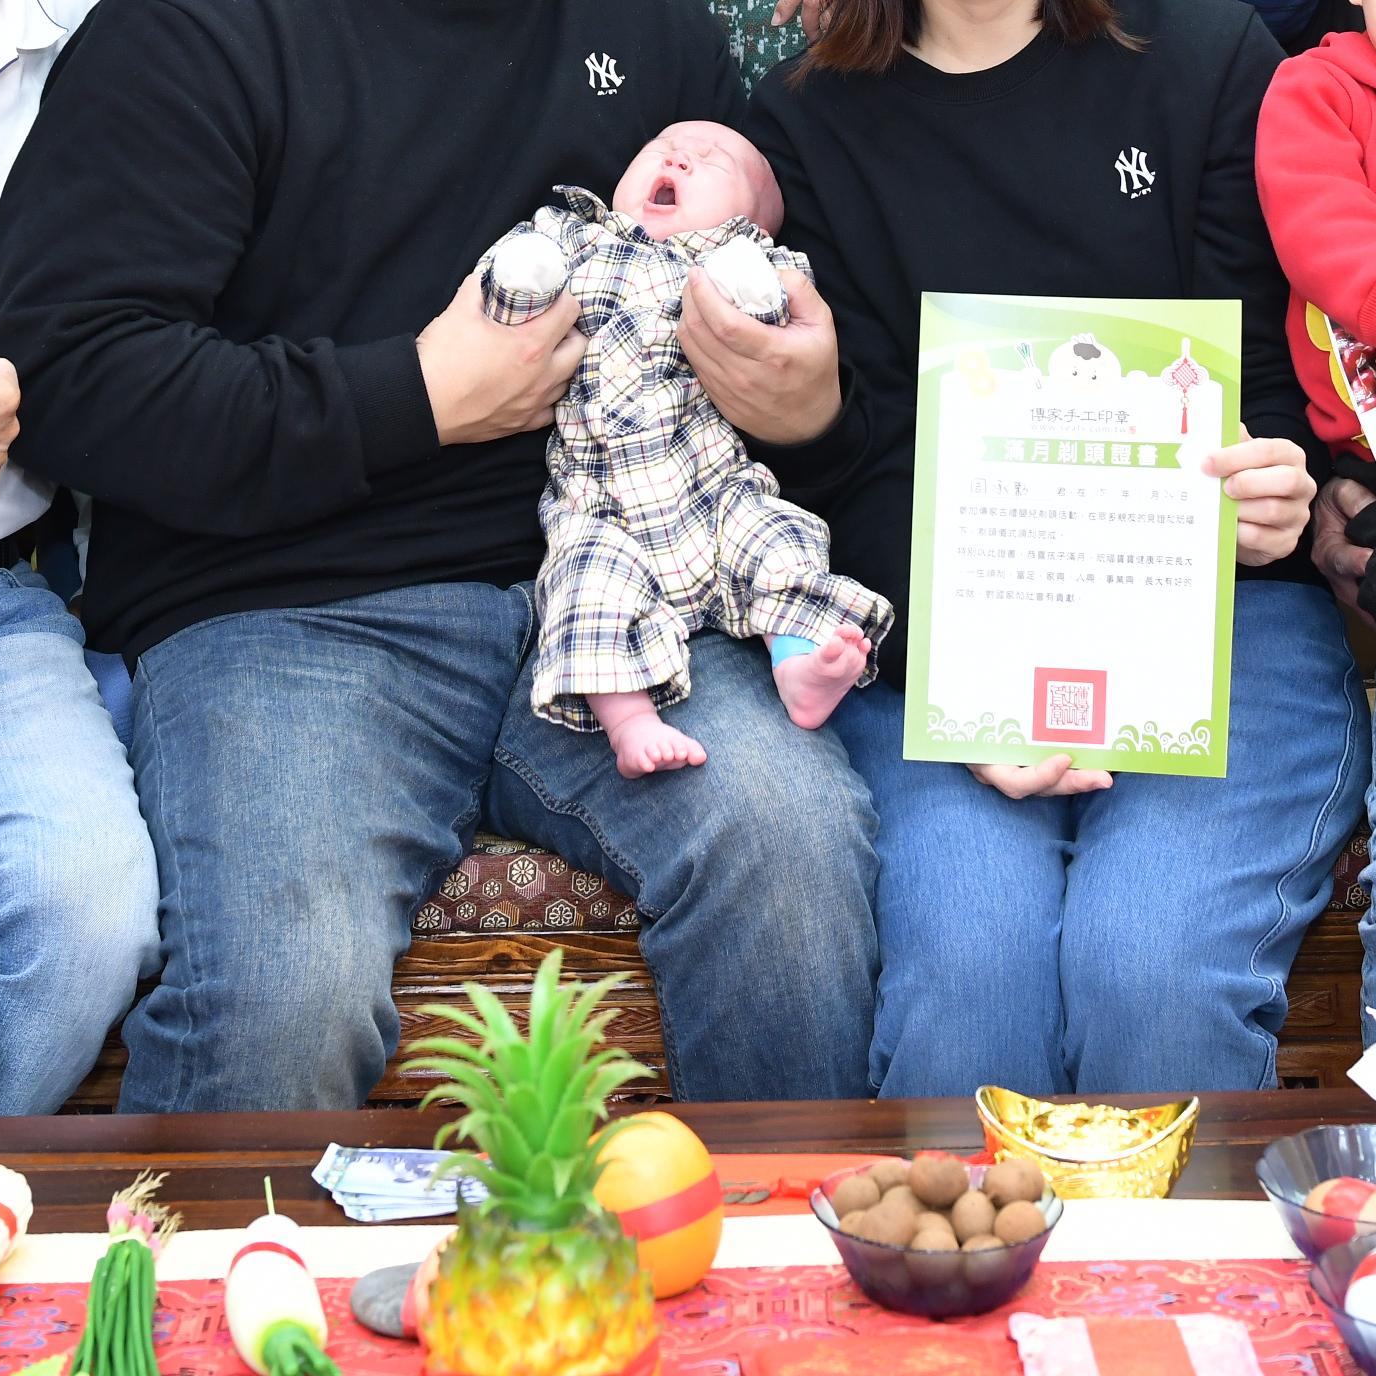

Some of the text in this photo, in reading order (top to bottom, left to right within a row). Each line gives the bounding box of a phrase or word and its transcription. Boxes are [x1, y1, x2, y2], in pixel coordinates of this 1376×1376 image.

[1029, 407, 1131, 425] 傳家手工印章
[1004, 439, 1159, 466] 滿月剃頭證書
